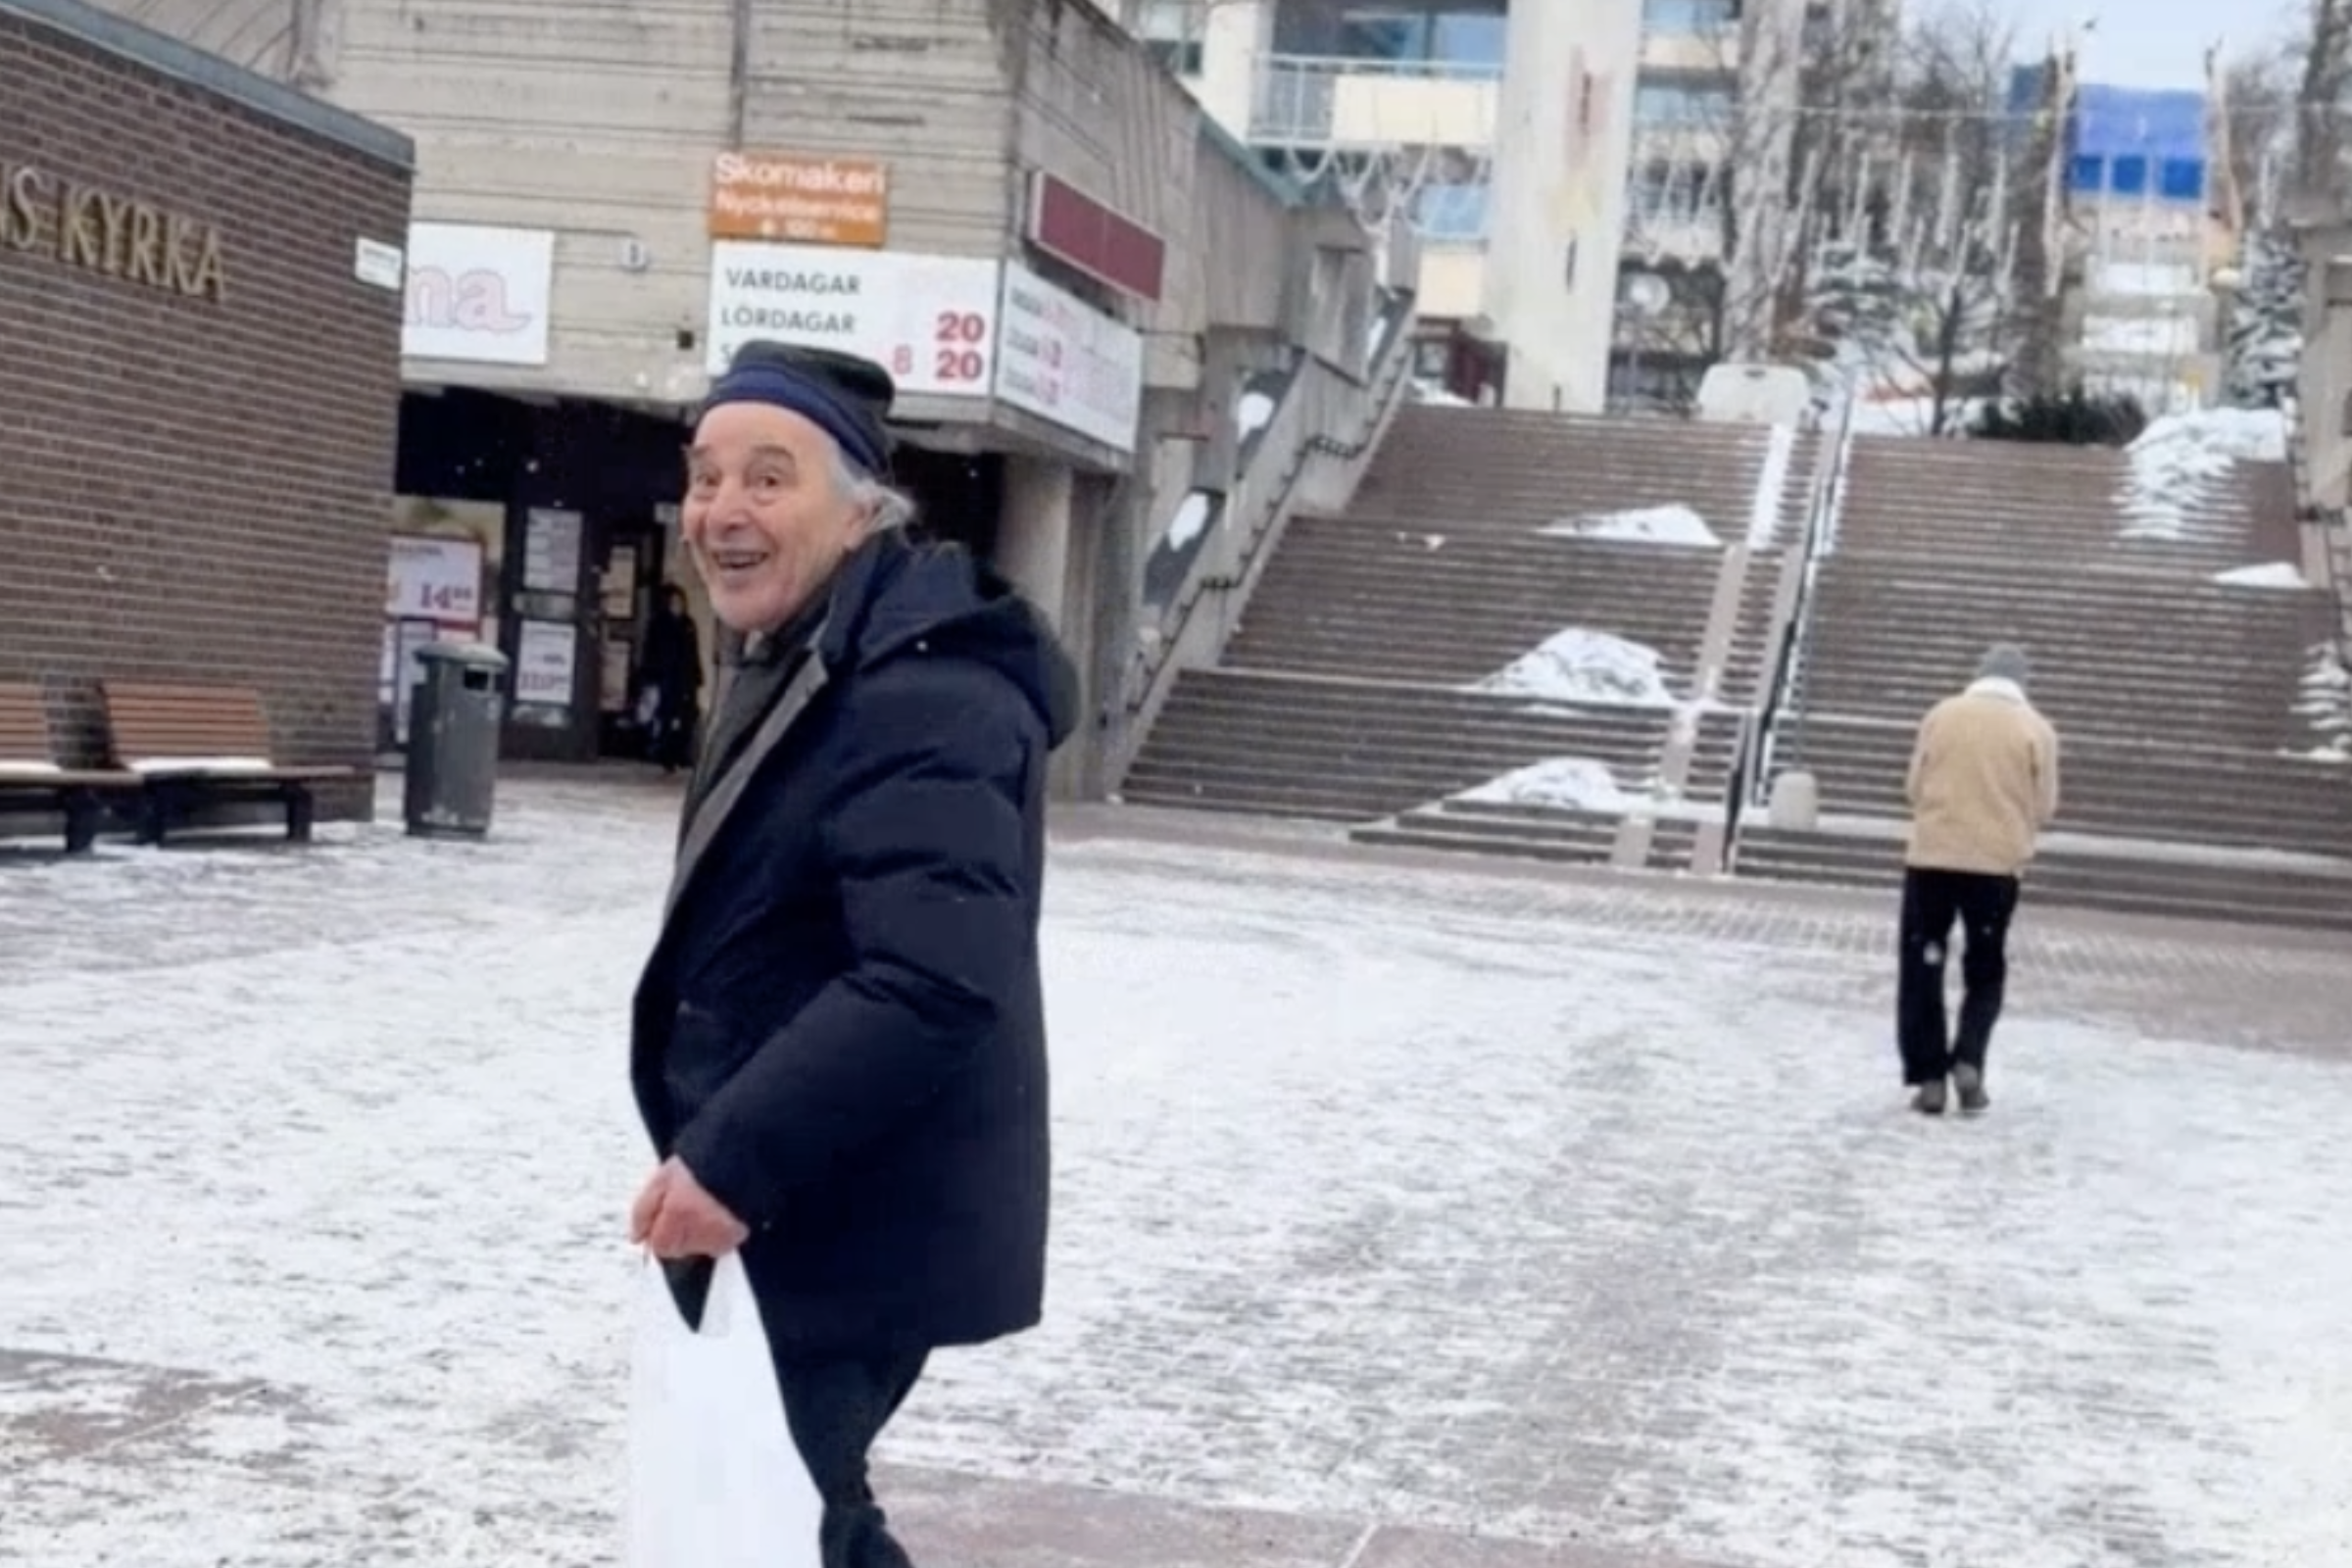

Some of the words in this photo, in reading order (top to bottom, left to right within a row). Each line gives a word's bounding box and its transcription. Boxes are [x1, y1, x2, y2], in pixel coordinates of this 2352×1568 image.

[714, 152, 886, 193] Skomakeri
[61, 181, 226, 301] KYRKA
[725, 268, 861, 295] VARDAGAR
[935, 311, 985, 343] 20
[935, 350, 984, 381] 20
